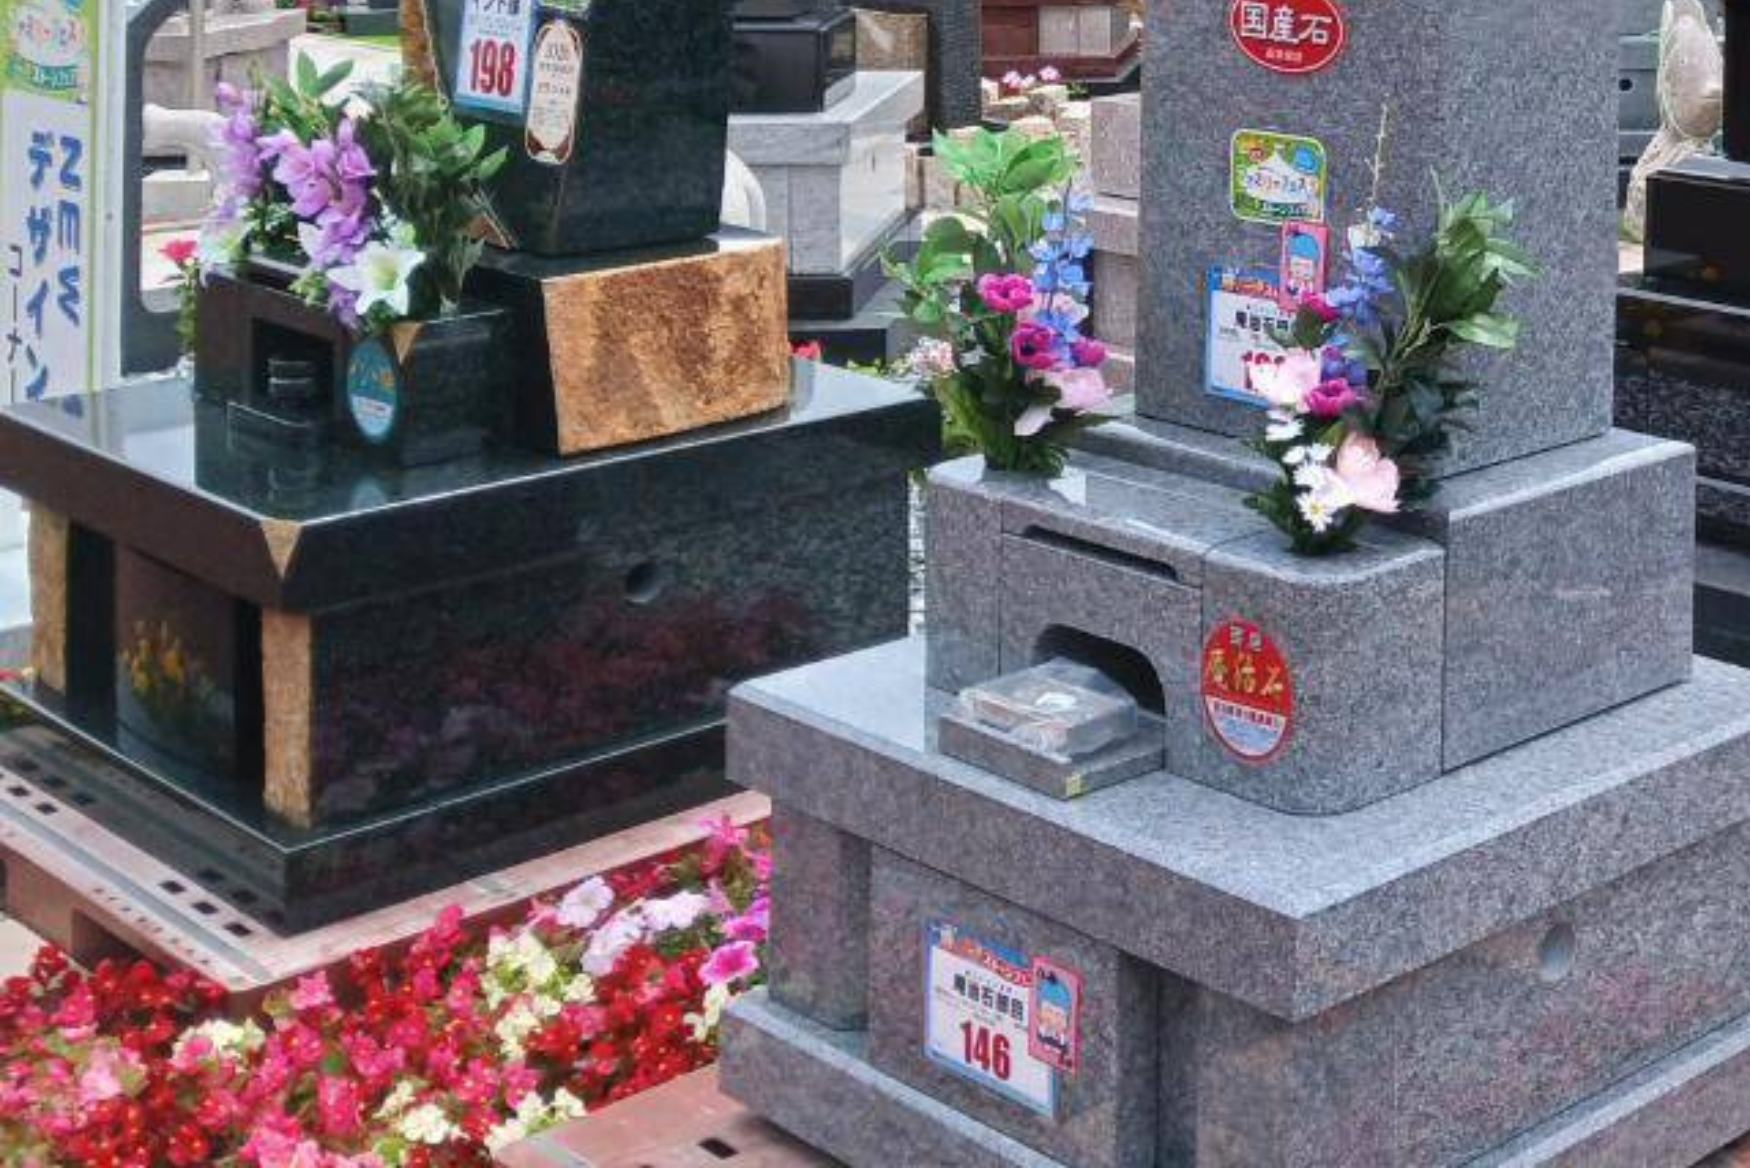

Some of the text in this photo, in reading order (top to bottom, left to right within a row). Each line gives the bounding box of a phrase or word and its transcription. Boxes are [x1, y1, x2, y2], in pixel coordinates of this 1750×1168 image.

[1240, 0, 1333, 46] 国産石
[469, 38, 516, 97] 198
[57, 135, 83, 327] NEW
[26, 130, 54, 403] デザイン
[961, 1020, 1011, 1081] 146
